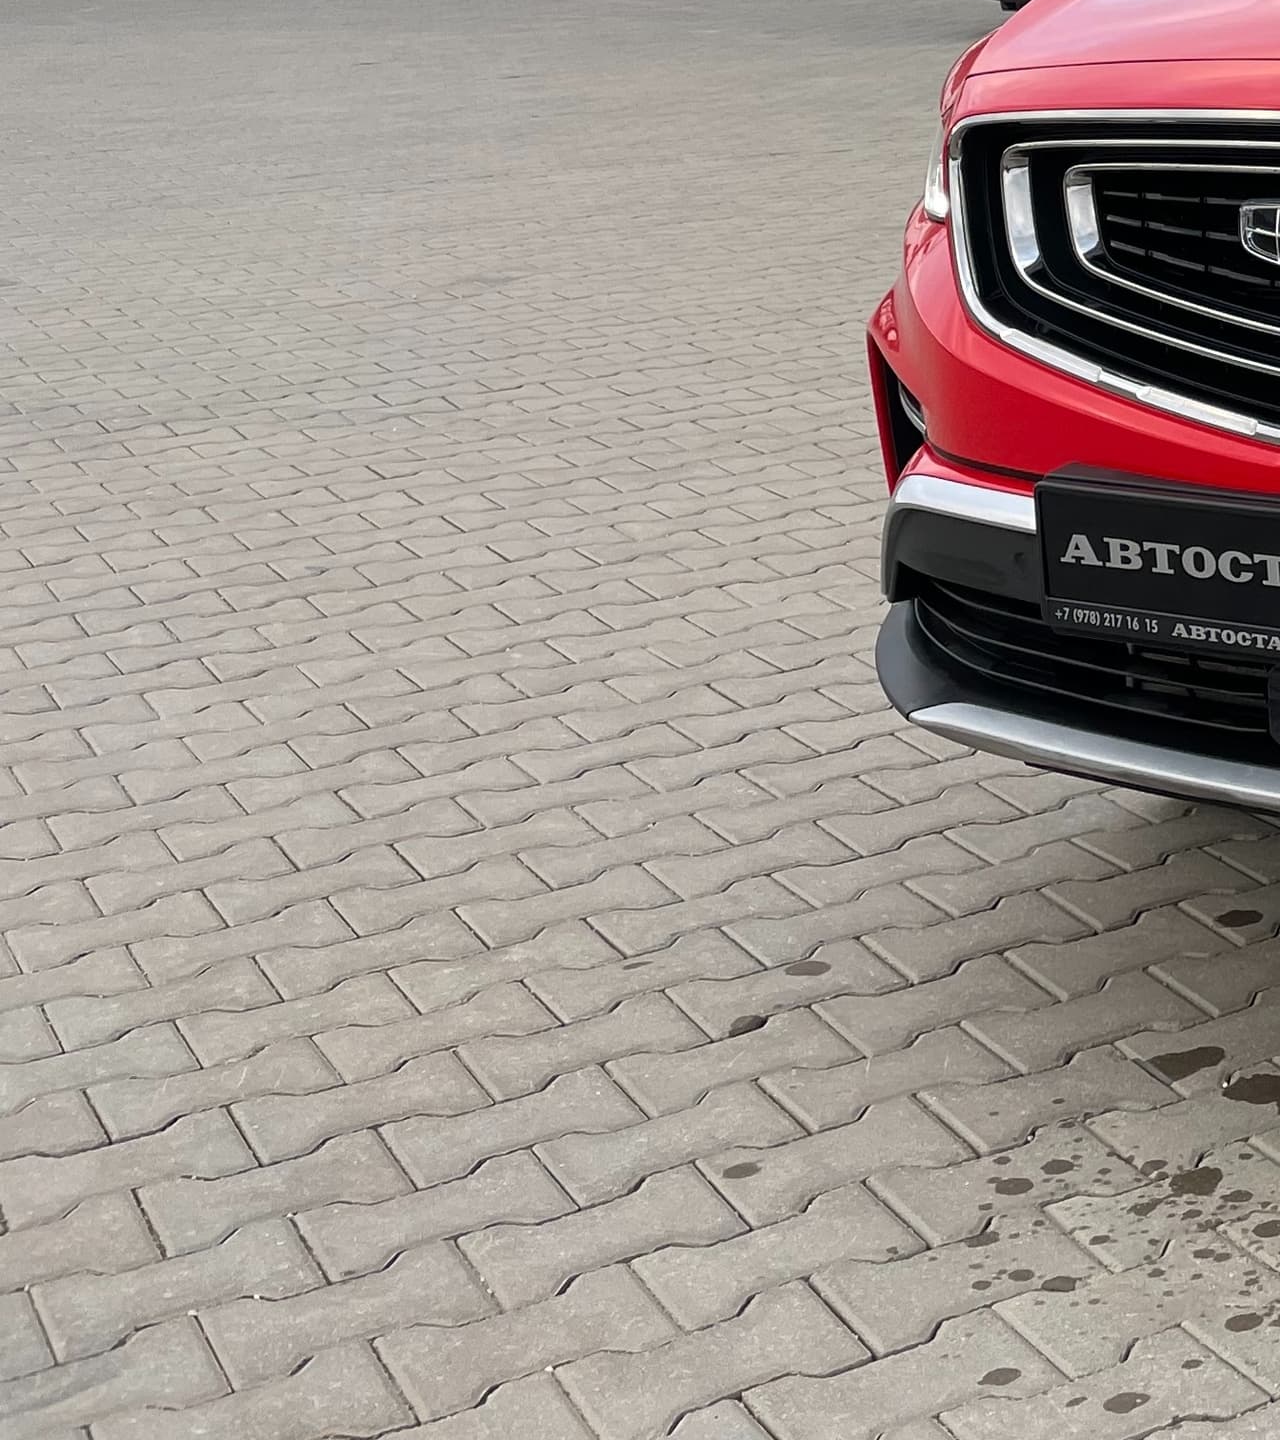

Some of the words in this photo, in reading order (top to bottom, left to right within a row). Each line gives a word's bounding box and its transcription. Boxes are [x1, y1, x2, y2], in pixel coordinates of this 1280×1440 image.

[1055, 607, 1070, 621] +7
[1073, 608, 1100, 627] (978)
[1103, 613, 1123, 628] 217
[1126, 615, 1140, 631] 16
[1145, 618, 1159, 633] 15
